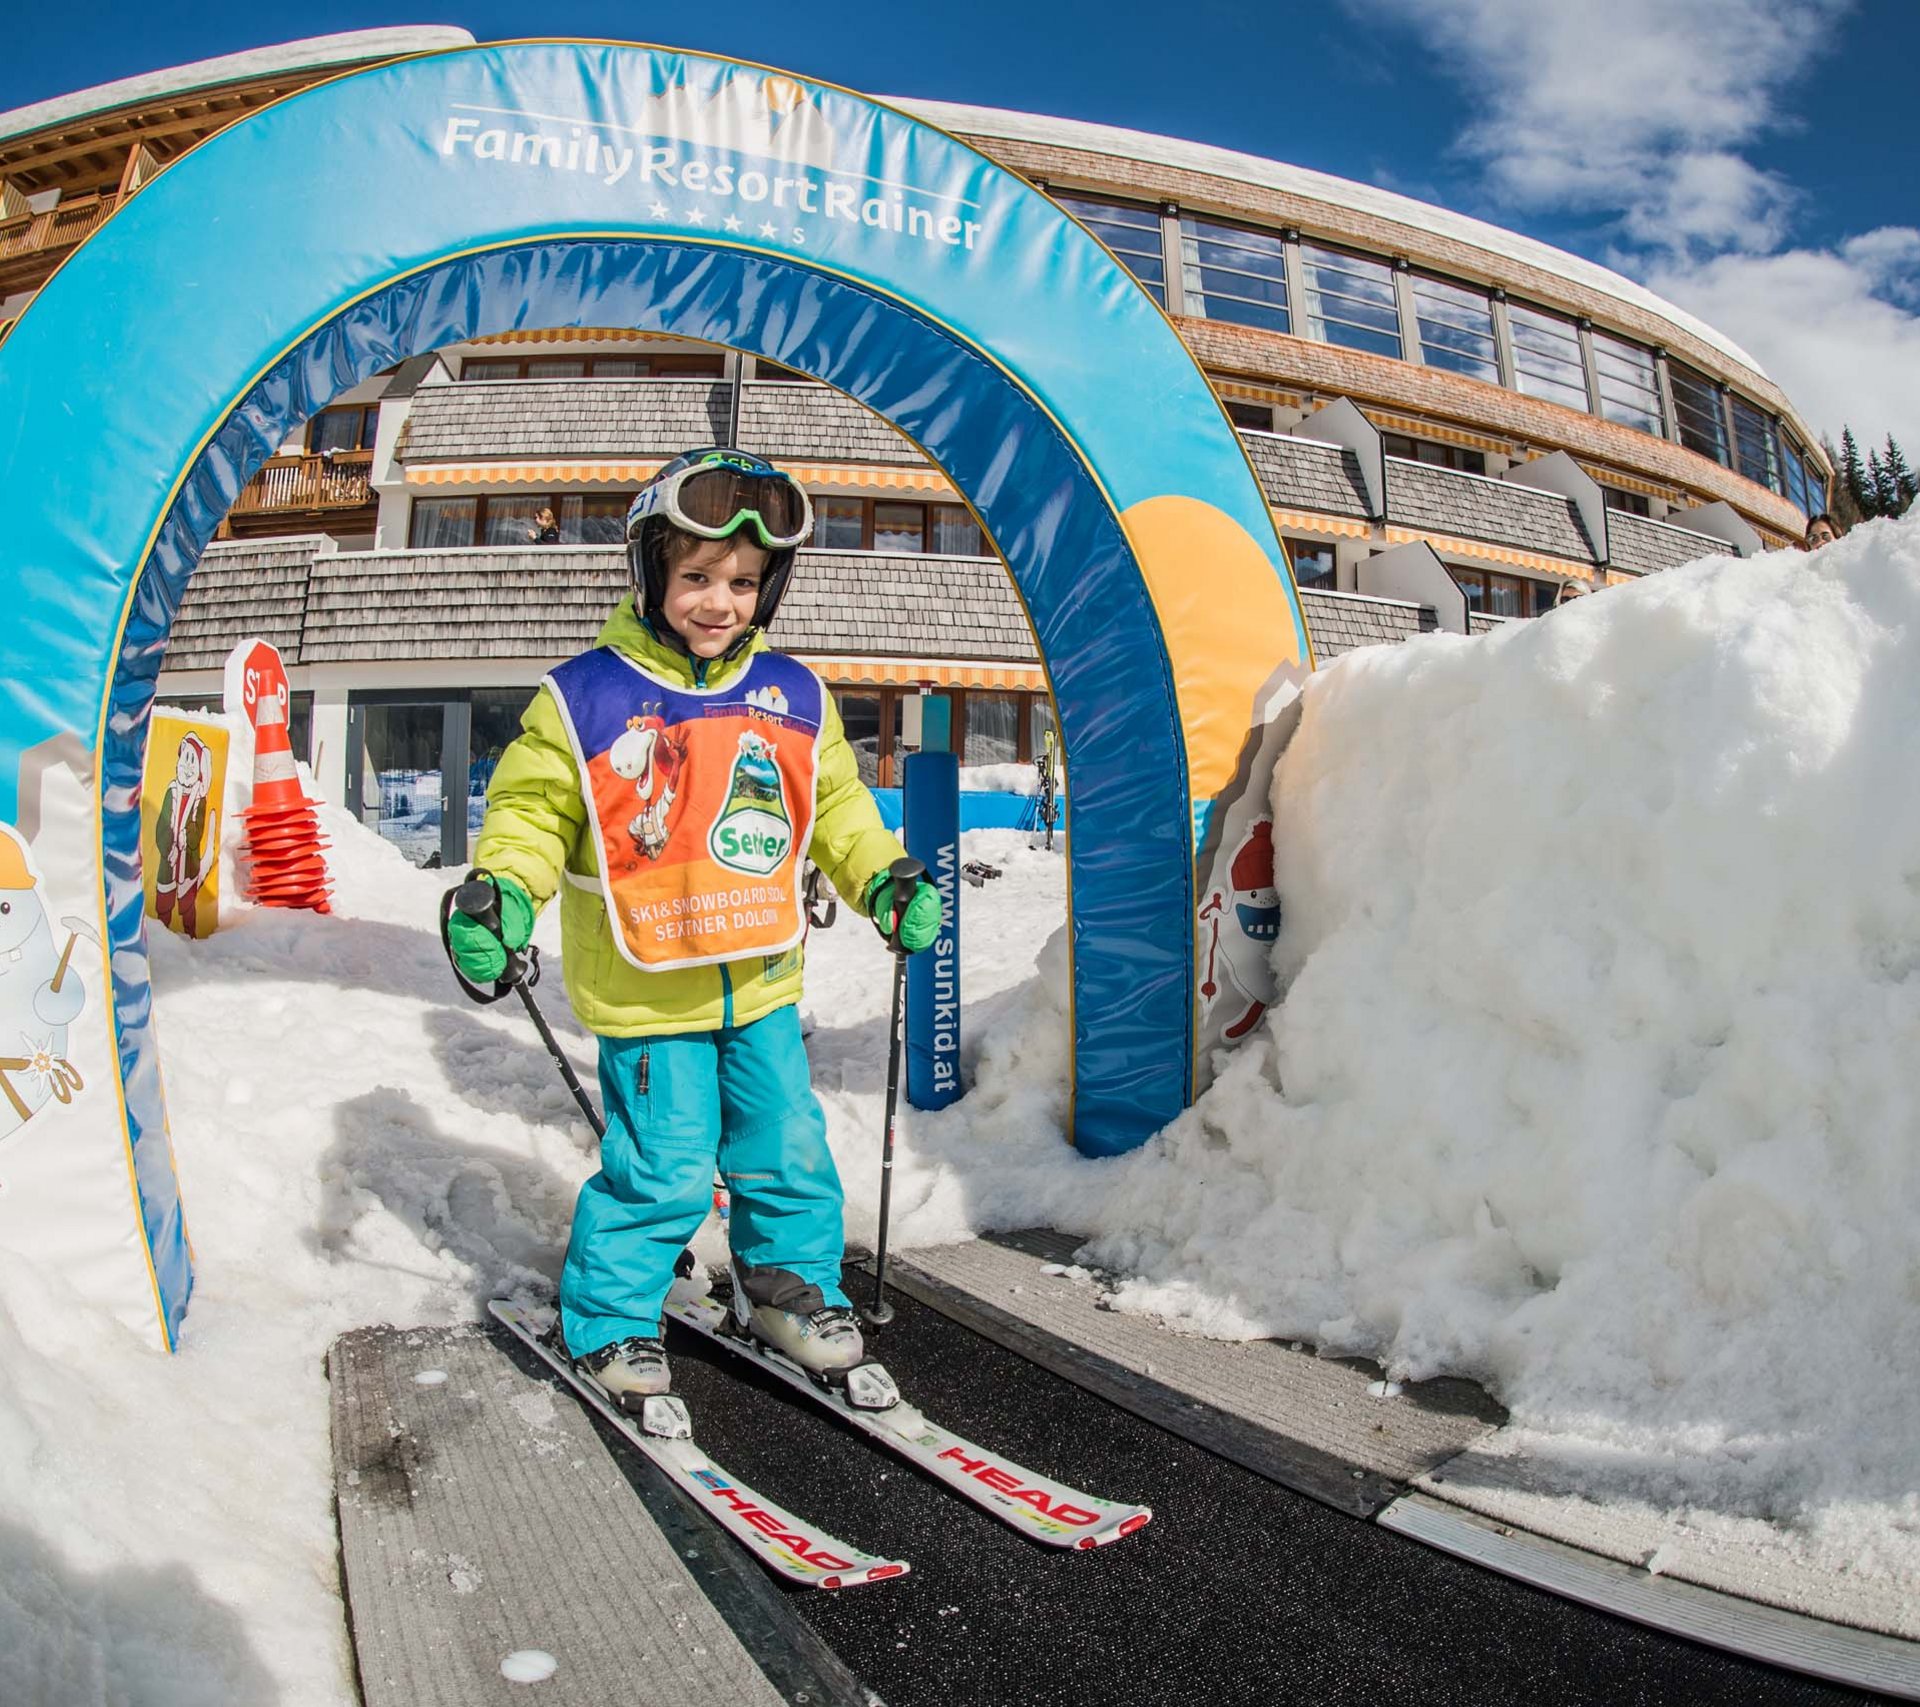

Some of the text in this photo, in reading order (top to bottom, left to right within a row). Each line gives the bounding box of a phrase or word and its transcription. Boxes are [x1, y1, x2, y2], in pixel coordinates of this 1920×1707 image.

[655, 914, 728, 942] SEXTNER
[933, 843, 957, 1092] www.sunkid.at
[937, 1447, 1101, 1526] HEAD
[711, 1488, 855, 1571] HEAD
